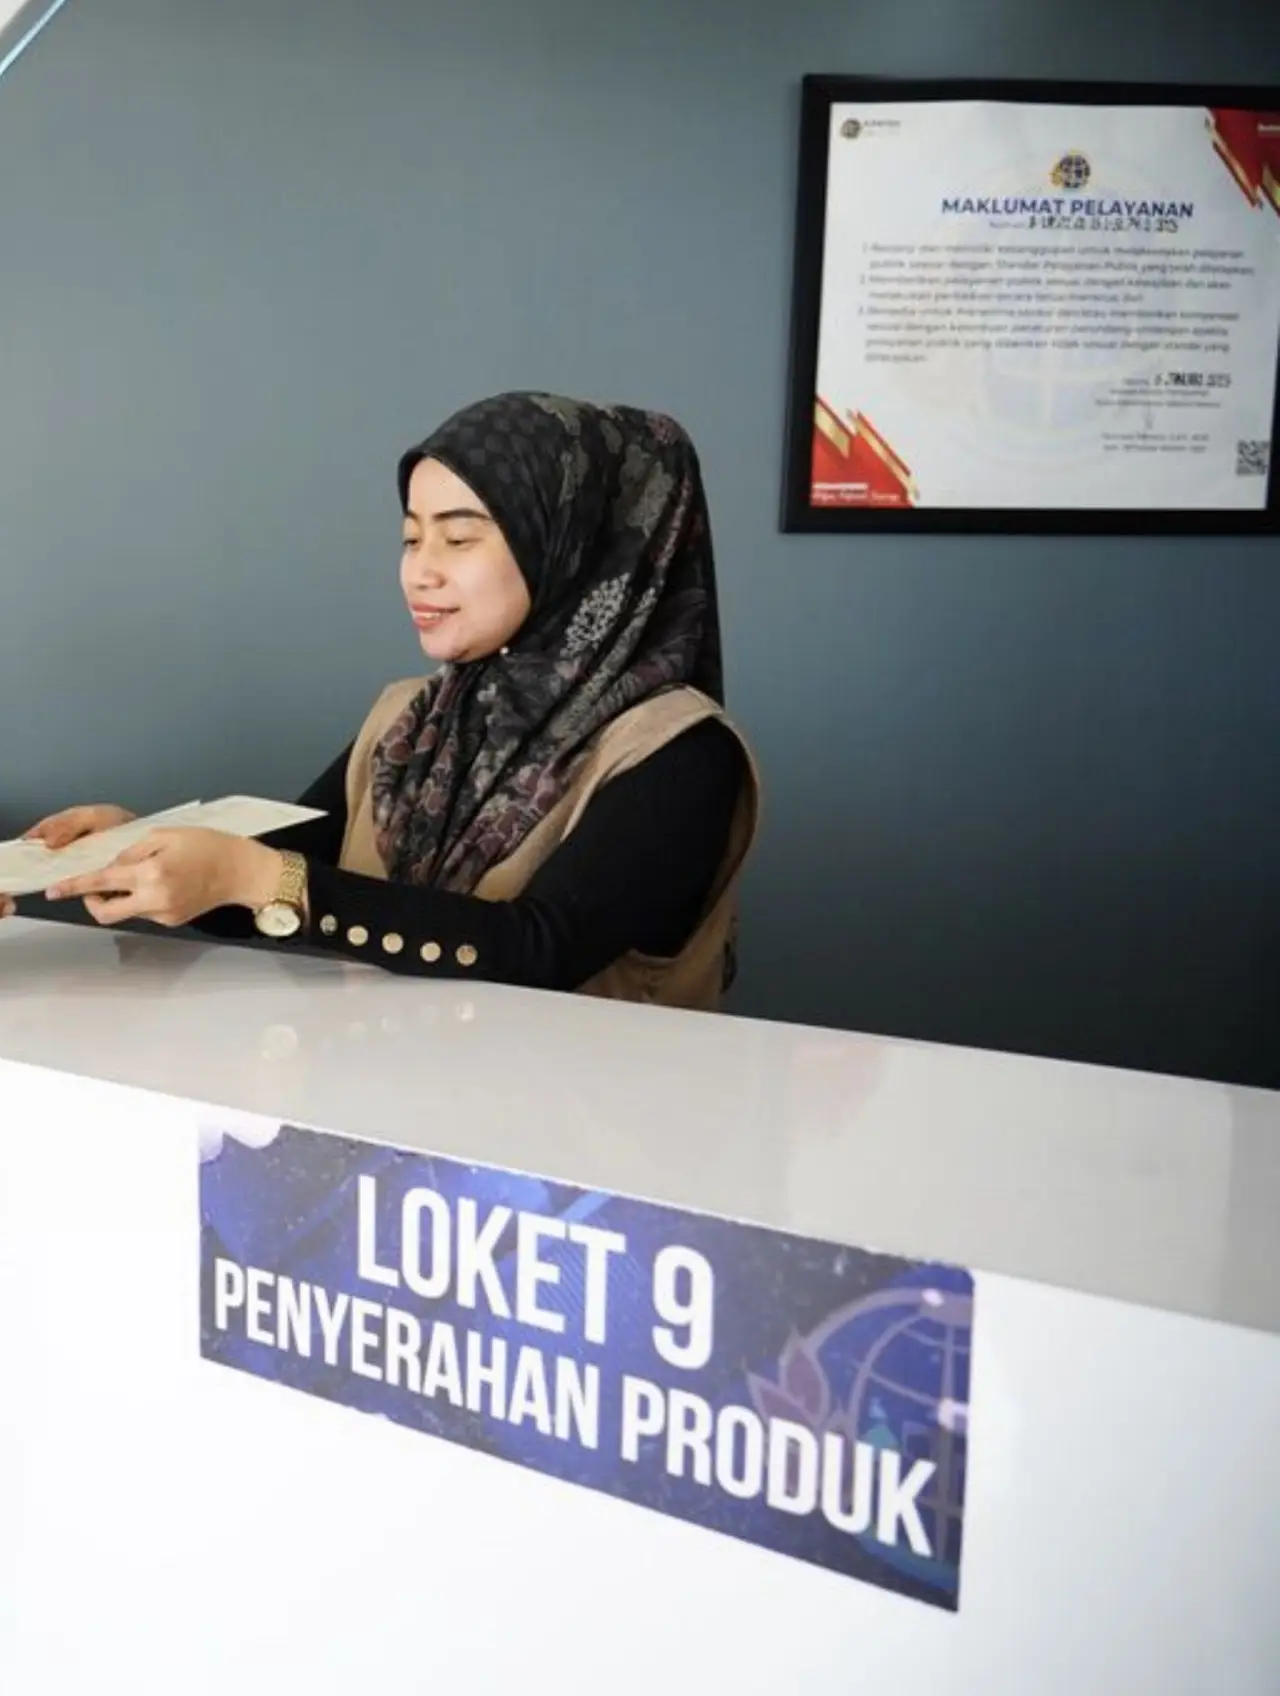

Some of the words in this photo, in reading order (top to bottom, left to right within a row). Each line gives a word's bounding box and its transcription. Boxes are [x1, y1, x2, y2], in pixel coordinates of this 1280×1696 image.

[941, 198, 1065, 215] MAKLUMAT
[1069, 199, 1195, 218] PELAYANAN
[357, 1174, 626, 1346] LOKET
[652, 1244, 715, 1371] 9
[214, 1257, 601, 1451] PENYERAHAN
[620, 1373, 938, 1558] PRODUK
